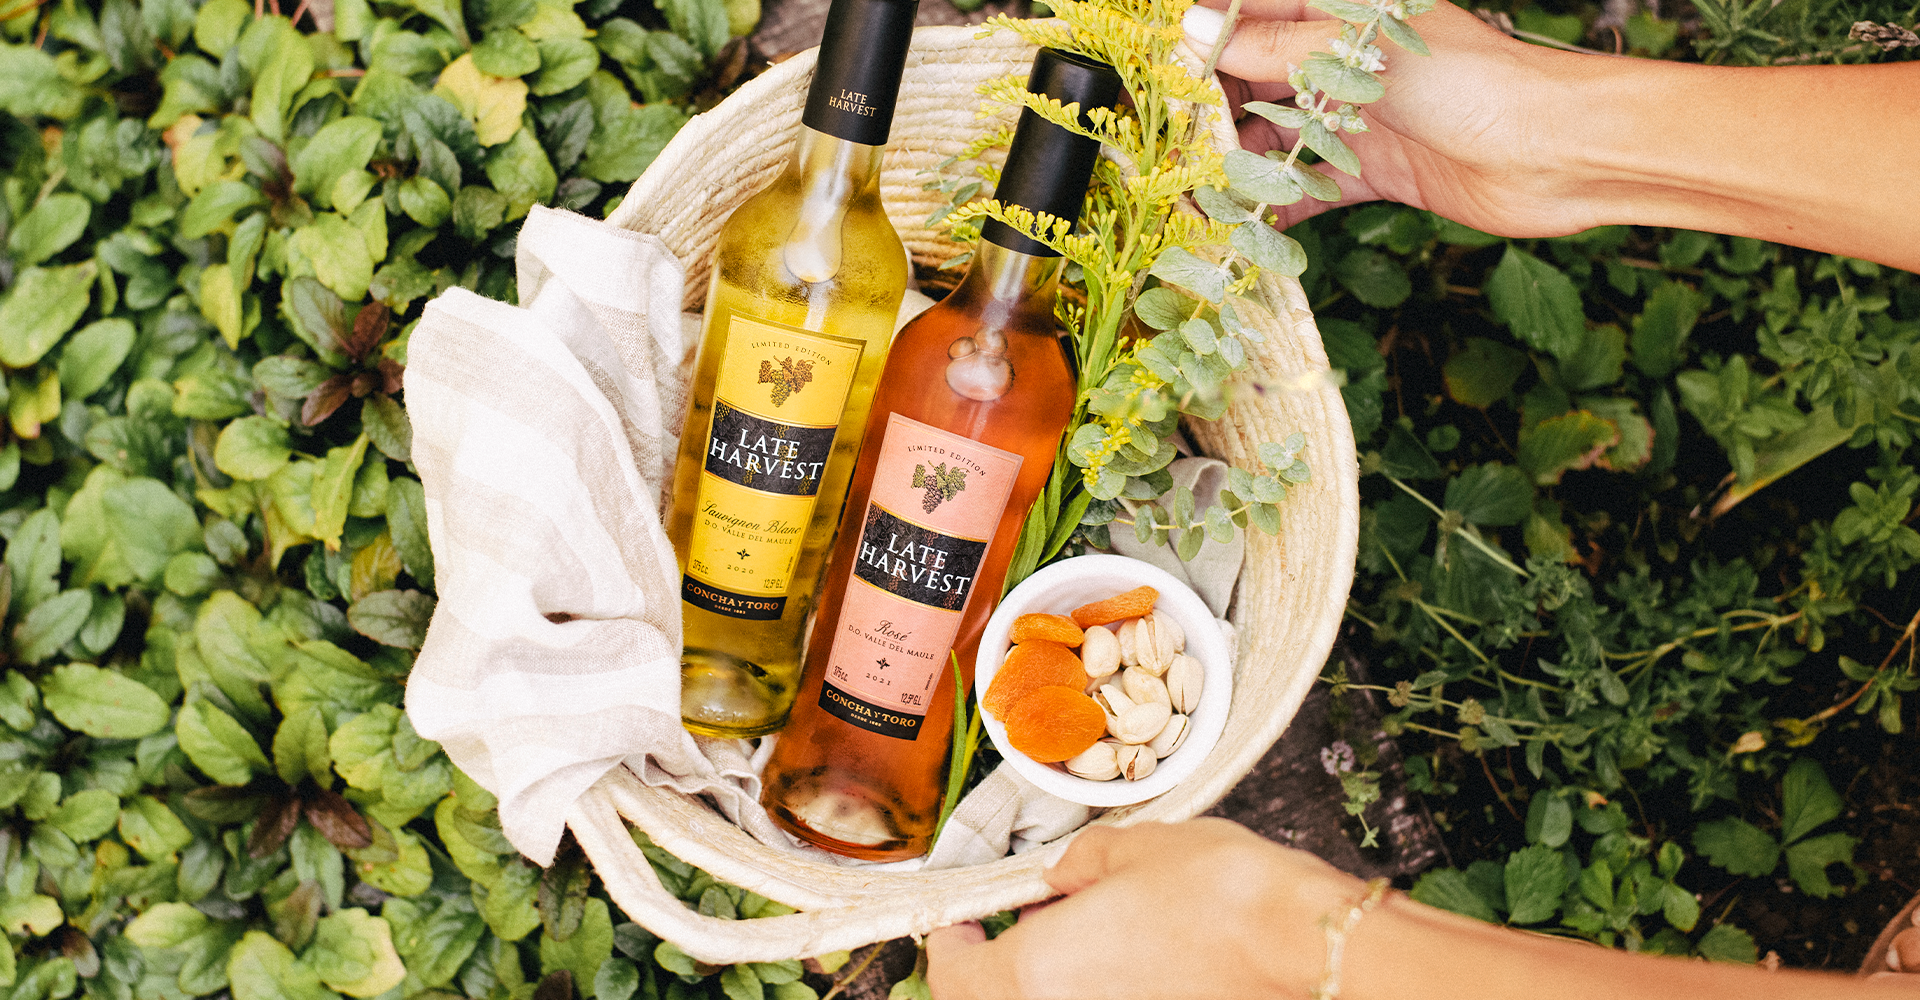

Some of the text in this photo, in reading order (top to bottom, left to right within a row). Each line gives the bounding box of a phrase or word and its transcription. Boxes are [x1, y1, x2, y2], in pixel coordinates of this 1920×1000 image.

[828, 95, 878, 118] HARVEST
[840, 88, 868, 105] LATE
[751, 341, 832, 366] LIMITED EDITION
[738, 428, 801, 459] LATE
[709, 437, 824, 480] HARVEST
[907, 445, 987, 477] LIMITED EDITION
[701, 500, 802, 535] Sauvignon Blanc
[704, 519, 793, 545] D.O. VALLE DEL MAULE
[886, 532, 949, 570] LATE
[727, 564, 754, 575] 2020
[859, 541, 971, 595] HARVEST
[686, 583, 736, 607] CONCHA
[745, 601, 779, 611] TORO
[848, 624, 935, 660] D.O. VALLE DEL MAULE
[874, 619, 913, 642] Rosé
[865, 672, 892, 686] 2021
[826, 689, 872, 717] CONCHA
[881, 713, 916, 728] TORO
